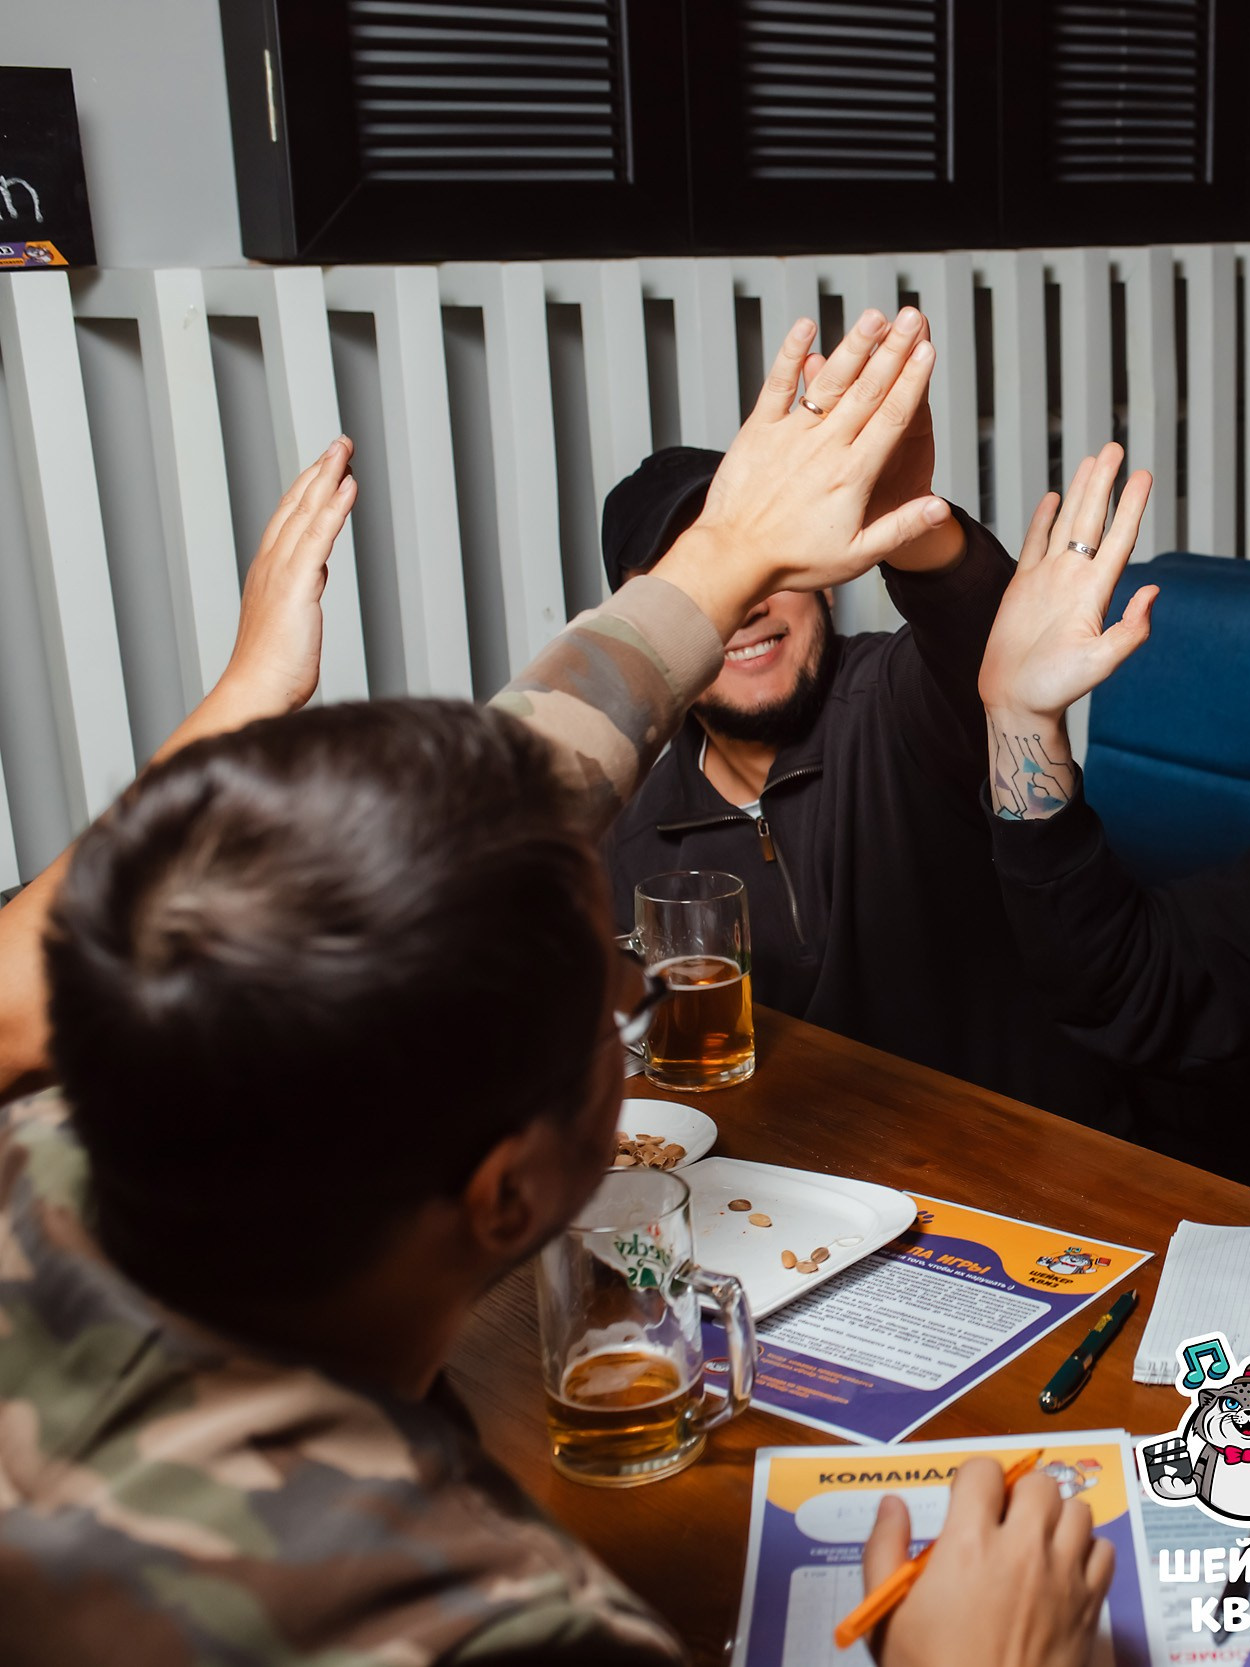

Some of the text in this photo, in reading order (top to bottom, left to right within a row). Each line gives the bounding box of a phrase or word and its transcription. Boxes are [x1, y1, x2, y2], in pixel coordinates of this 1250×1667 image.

[936, 1254, 992, 1274] ИГРЫ
[1029, 1270, 1074, 1284] ШЕЙКЕР
[1029, 1277, 1059, 1288] КВИЗ
